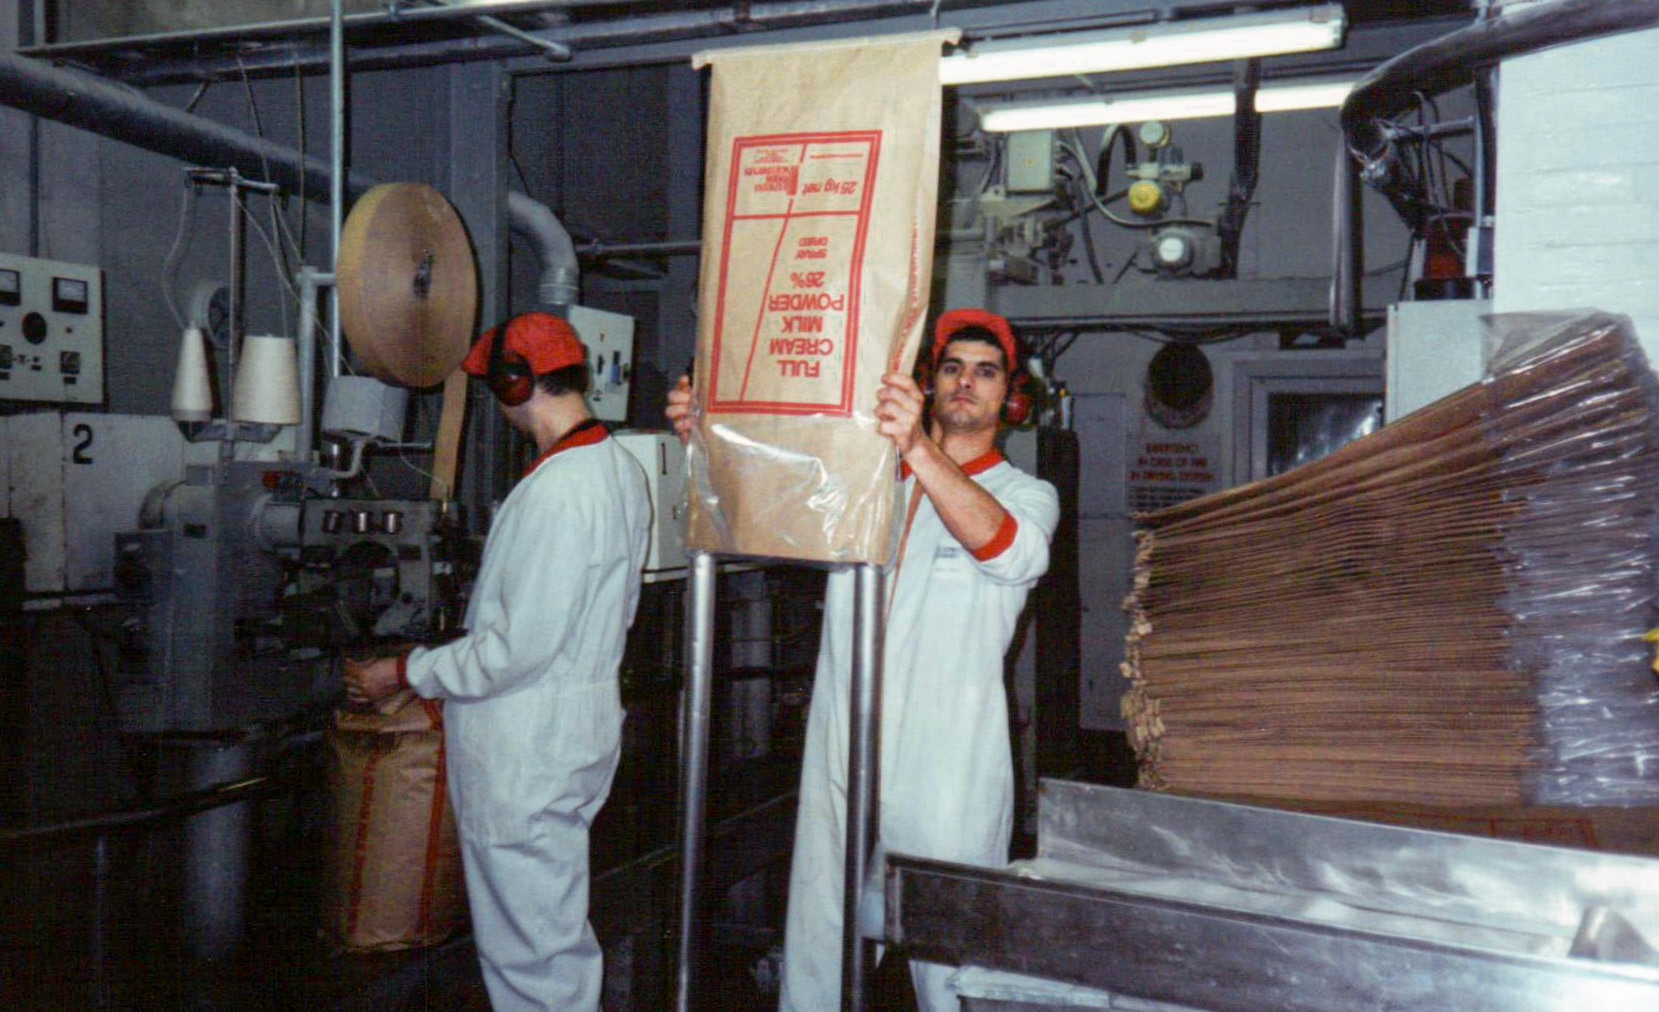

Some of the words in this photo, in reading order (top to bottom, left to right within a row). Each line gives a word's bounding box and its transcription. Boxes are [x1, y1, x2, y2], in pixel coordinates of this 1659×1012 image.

[802, 181, 821, 195] net
[824, 178, 839, 194] kg
[841, 181, 857, 194] 25
[795, 249, 828, 259] SPRAY
[790, 271, 825, 289] 26%
[768, 293, 844, 311] POWDER
[781, 315, 823, 333] MILK
[770, 338, 834, 356] CREAM
[777, 360, 820, 378] FULL
[72, 423, 93, 465] 2
